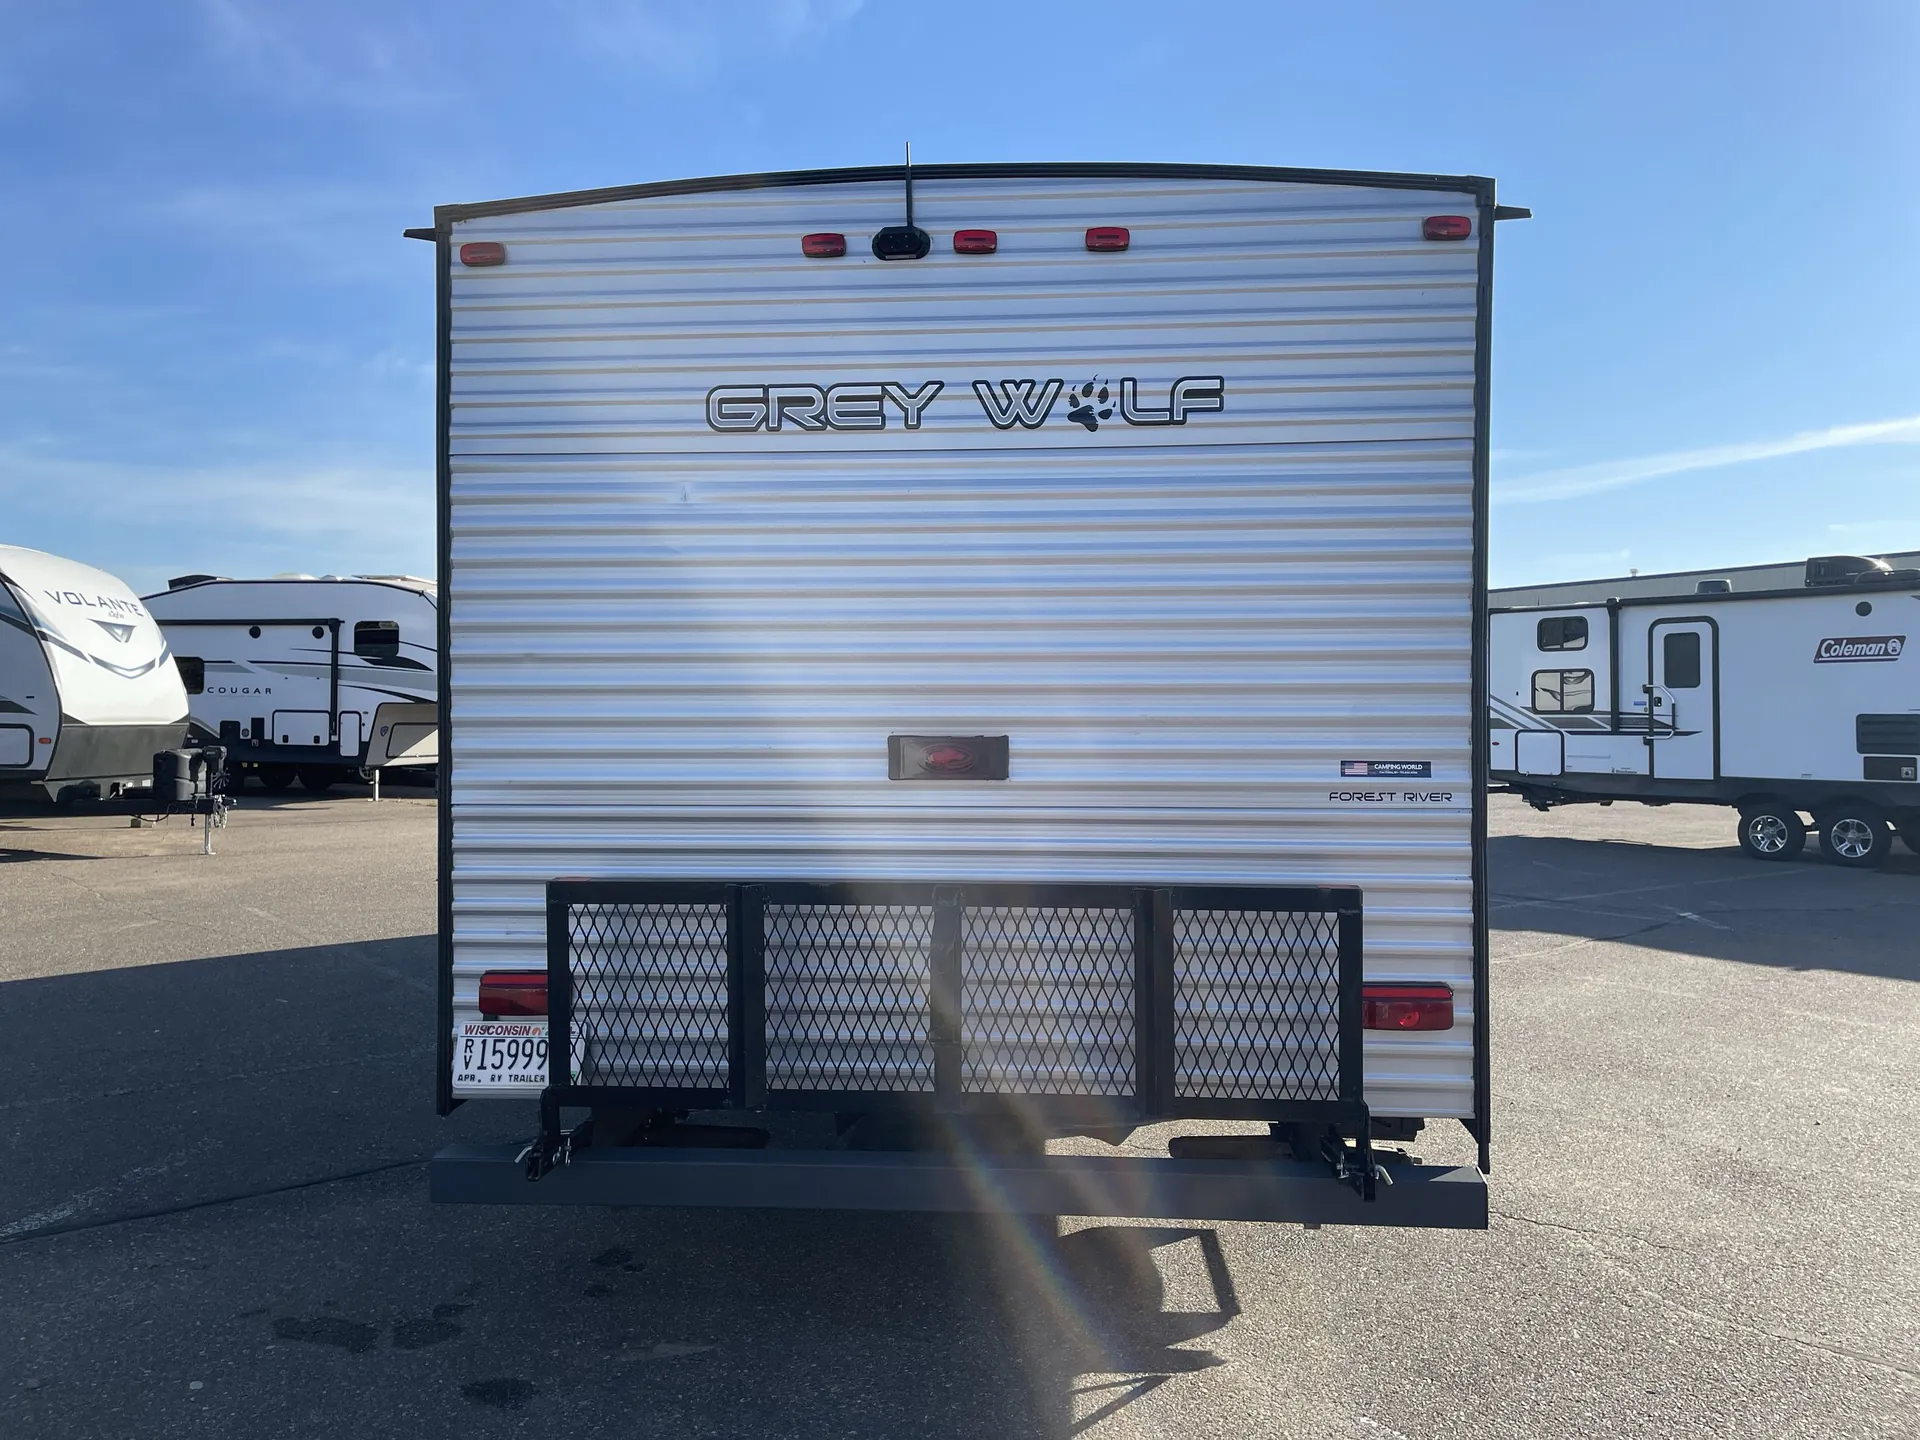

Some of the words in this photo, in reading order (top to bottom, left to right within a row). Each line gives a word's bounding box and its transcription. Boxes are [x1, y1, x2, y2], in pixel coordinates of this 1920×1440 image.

[705, 380, 944, 432] GREY
[43, 590, 144, 617] VOLANTE
[1820, 639, 1886, 658] Coleman
[207, 686, 272, 695] COUGAR
[1329, 792, 1396, 802] FOREST
[1403, 792, 1452, 802] RIVER
[464, 1024, 531, 1036] WISCONSIN
[508, 1074, 545, 1083] TRAILER
